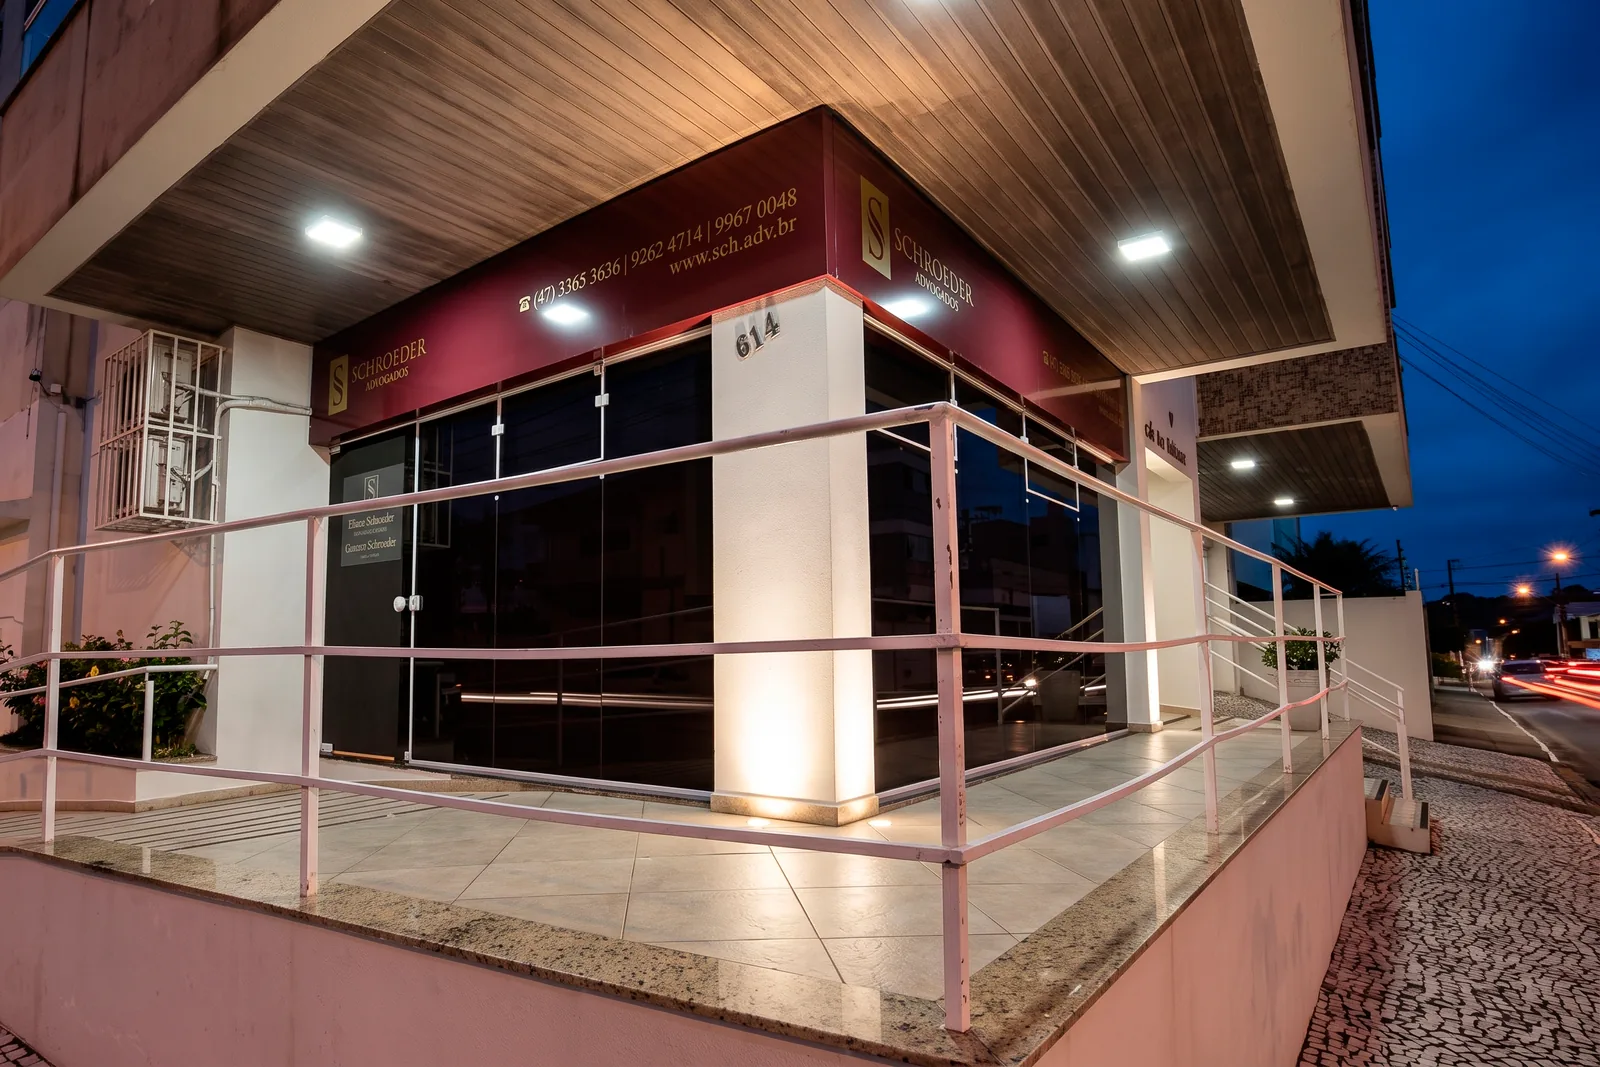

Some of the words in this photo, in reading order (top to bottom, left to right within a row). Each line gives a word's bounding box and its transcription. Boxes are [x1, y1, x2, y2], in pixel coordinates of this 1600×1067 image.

[533, 284, 556, 310] (47)
[558, 271, 586, 297] 3365
[589, 257, 620, 285] 3636
[631, 241, 664, 269] 9262
[667, 224, 703, 253] 4714
[715, 204, 752, 236] 9967
[756, 187, 797, 219] 0048
[669, 216, 797, 275] www.sch.adv.br
[894, 227, 975, 307] SCHROEDER
[915, 271, 959, 312] ADVOGADOS
[351, 338, 427, 384] SCHROEDER
[735, 311, 780, 361] 614
[365, 366, 409, 392] ADVOGADOS
